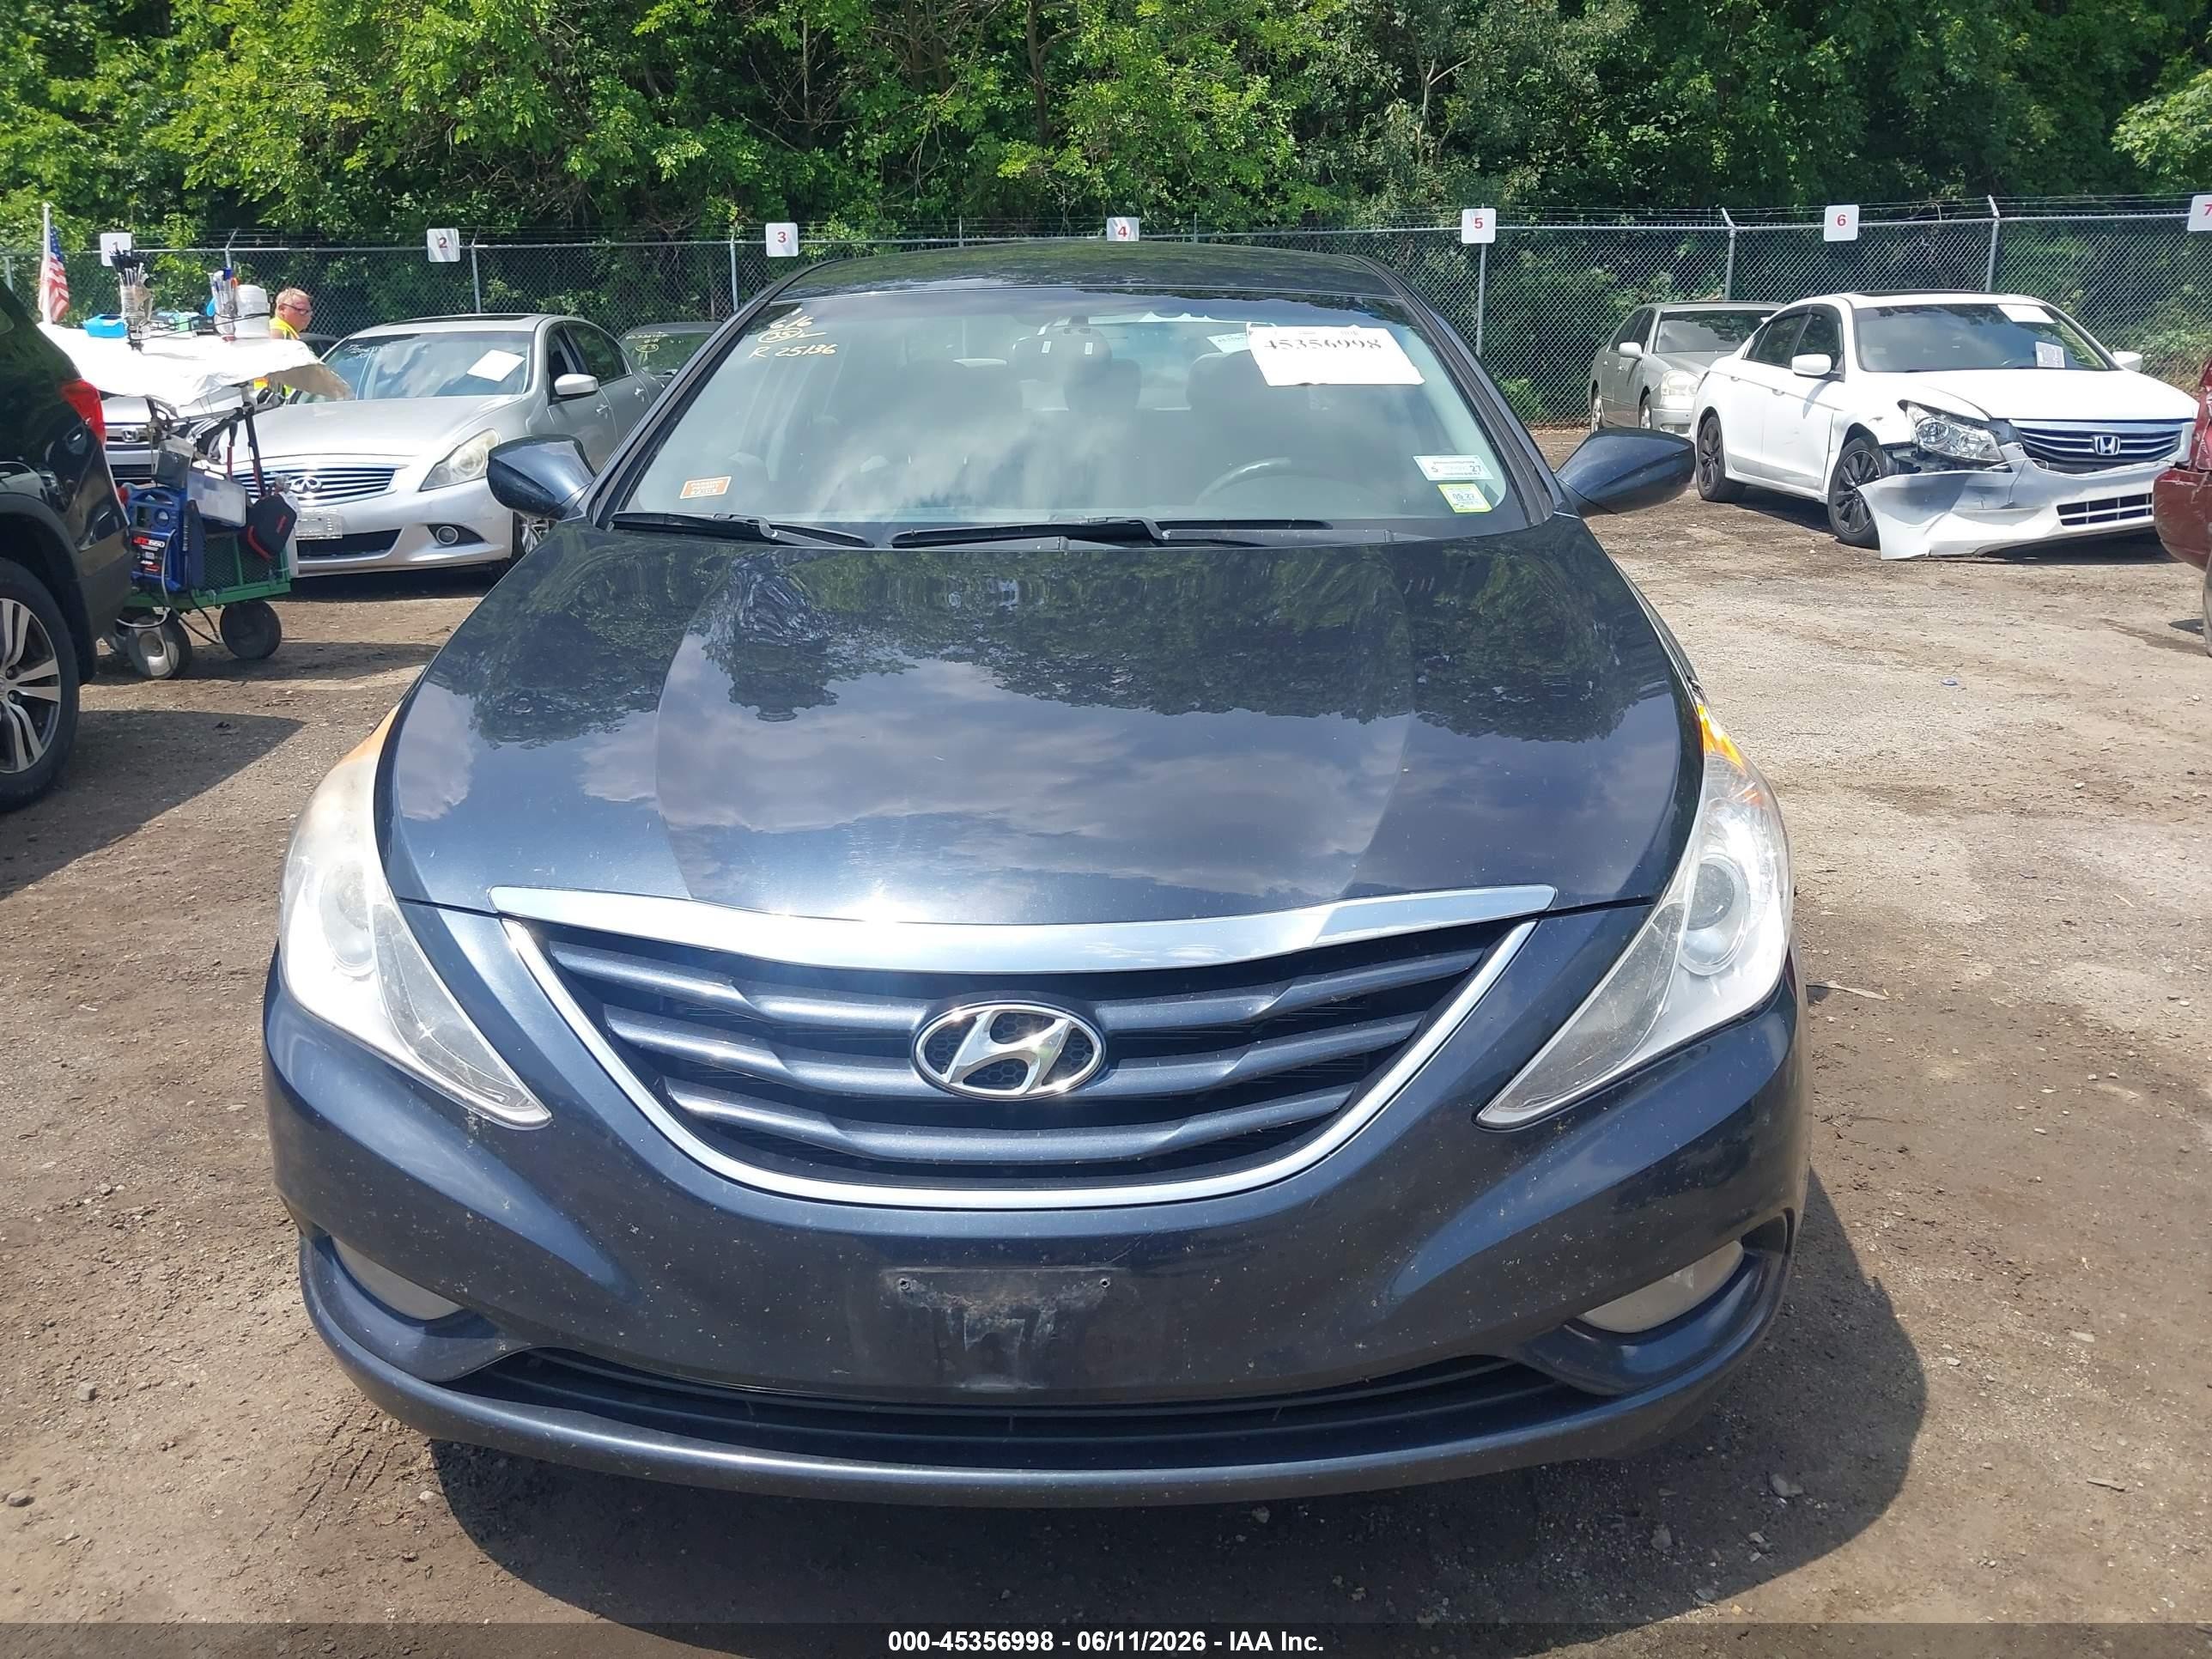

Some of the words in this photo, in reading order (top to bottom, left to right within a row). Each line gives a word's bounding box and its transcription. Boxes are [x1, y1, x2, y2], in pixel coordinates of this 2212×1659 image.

[2204, 204, 2212, 216] 7
[1474, 217, 1483, 229] 5
[1837, 214, 1846, 227] 6
[777, 231, 787, 243] 3
[1118, 226, 1127, 238] 4
[439, 236, 447, 249] 2
[1263, 338, 1382, 349] 45356998
[748, 346, 771, 359] R
